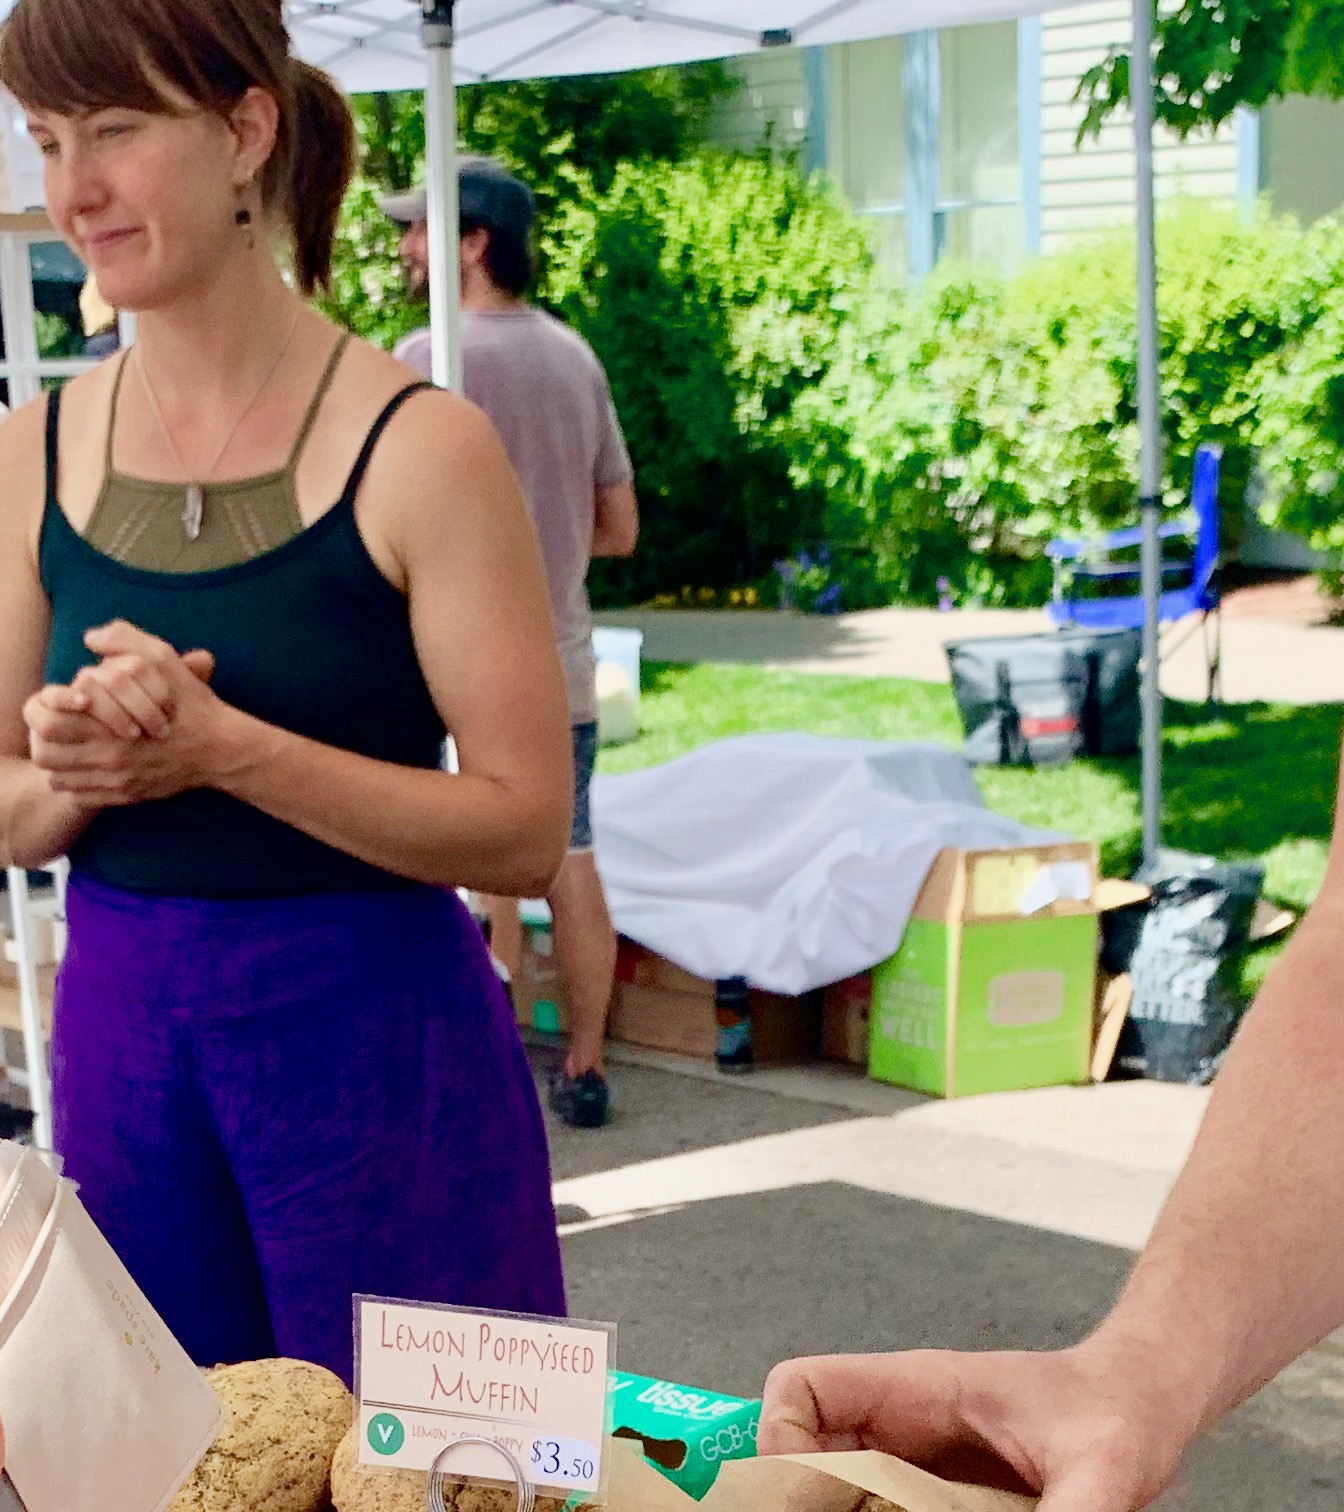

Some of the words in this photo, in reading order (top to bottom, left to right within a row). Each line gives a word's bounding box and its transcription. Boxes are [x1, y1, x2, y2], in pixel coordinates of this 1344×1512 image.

[380, 1310, 465, 1358] LEMON
[430, 1363, 538, 1414] MUFFIN
[412, 1424, 448, 1440] LEMON
[530, 1439, 594, 1480] $3.50
